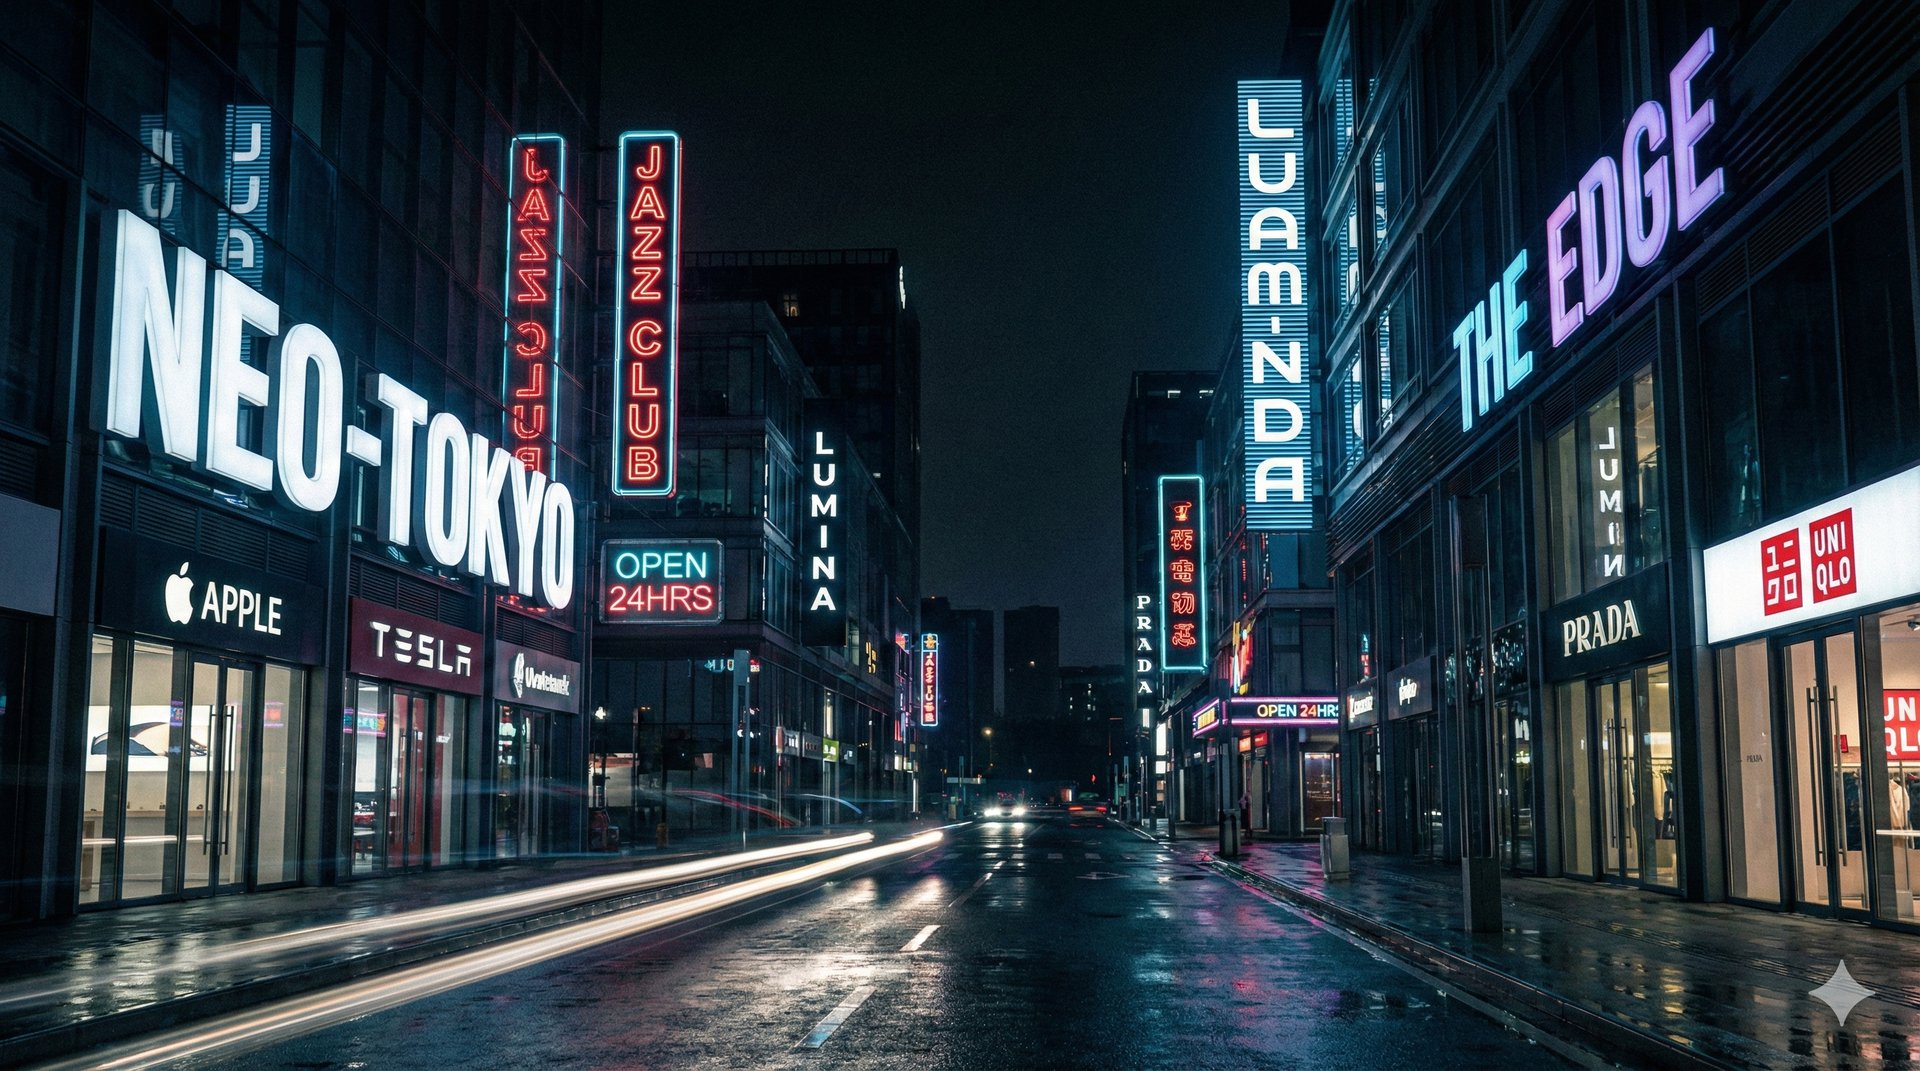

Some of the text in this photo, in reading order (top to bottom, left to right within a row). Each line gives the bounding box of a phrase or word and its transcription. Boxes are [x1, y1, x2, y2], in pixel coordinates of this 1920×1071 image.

[1453, 27, 1725, 433] THE EDGE
[628, 146, 665, 481] JAZZ CLUB
[107, 208, 575, 610] NEO-TOKYO
[809, 430, 837, 612] LUMINA
[1813, 521, 1847, 557] UNI
[615, 551, 707, 579] OPEN
[1816, 556, 1851, 595] QLO
[201, 580, 283, 636] APPLE
[608, 584, 713, 613] 24HRS
[370, 621, 472, 677] TESLA
[1137, 595, 1152, 694] PRADA
[1562, 600, 1642, 657] PRADA
[1257, 704, 1297, 718] OPEN
[1884, 727, 1920, 756] QL
